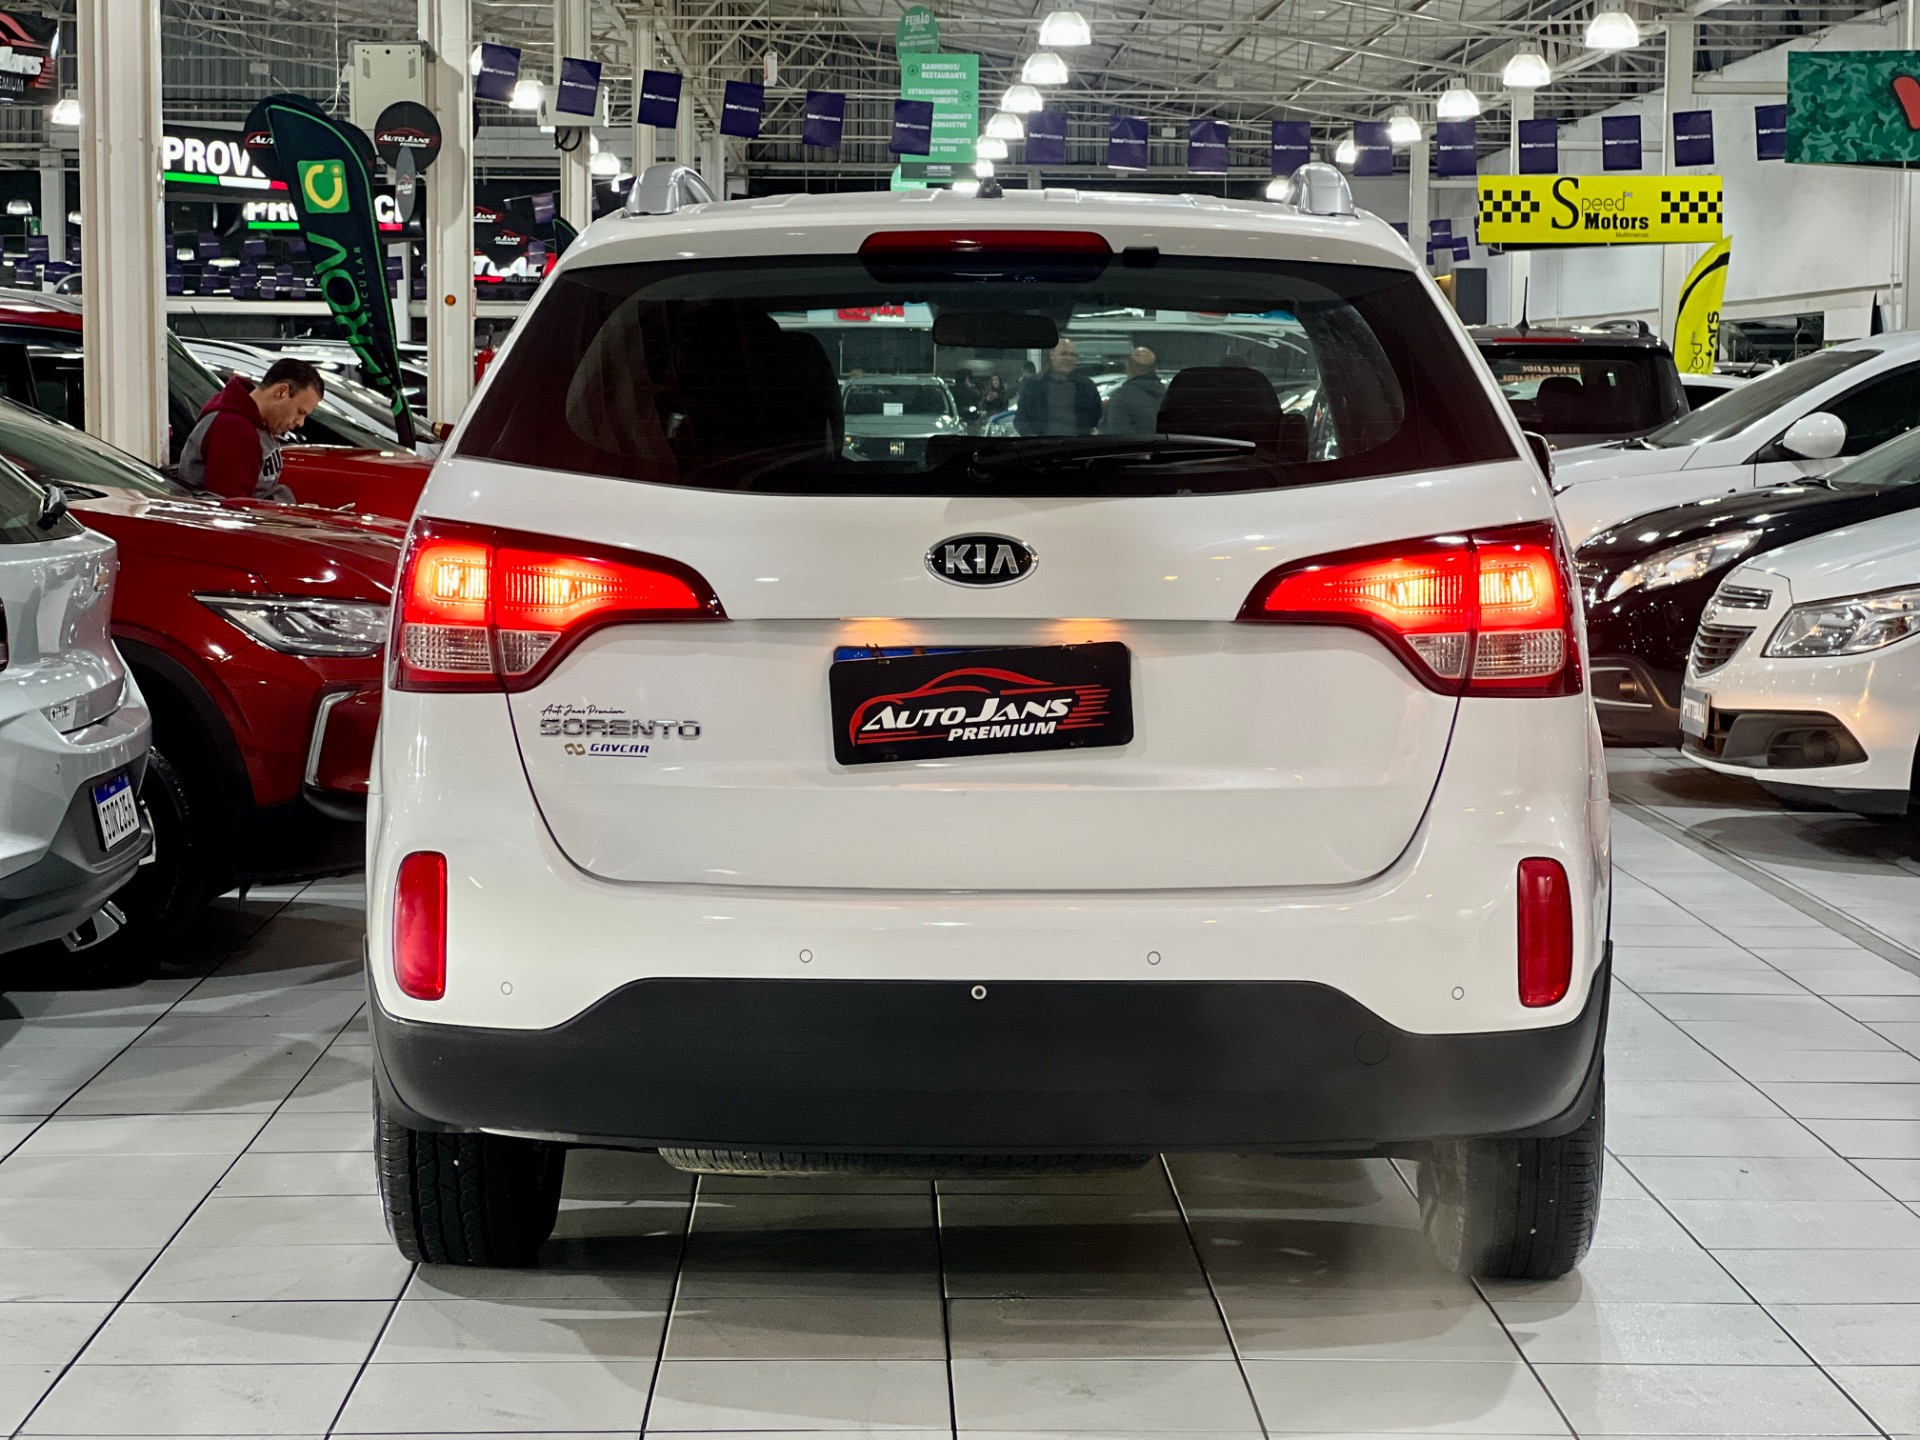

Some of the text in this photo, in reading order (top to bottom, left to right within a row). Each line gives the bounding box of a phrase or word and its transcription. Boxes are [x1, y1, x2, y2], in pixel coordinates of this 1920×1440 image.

[1551, 177, 1626, 230] Speed
[1584, 212, 1649, 230] Motors
[945, 544, 1019, 574] KIA
[563, 704, 586, 716] Jans
[586, 704, 626, 716] Premium
[540, 718, 702, 740] SORENTO
[947, 721, 1057, 742] PREMIUM
[590, 743, 651, 753] GAVCAR
